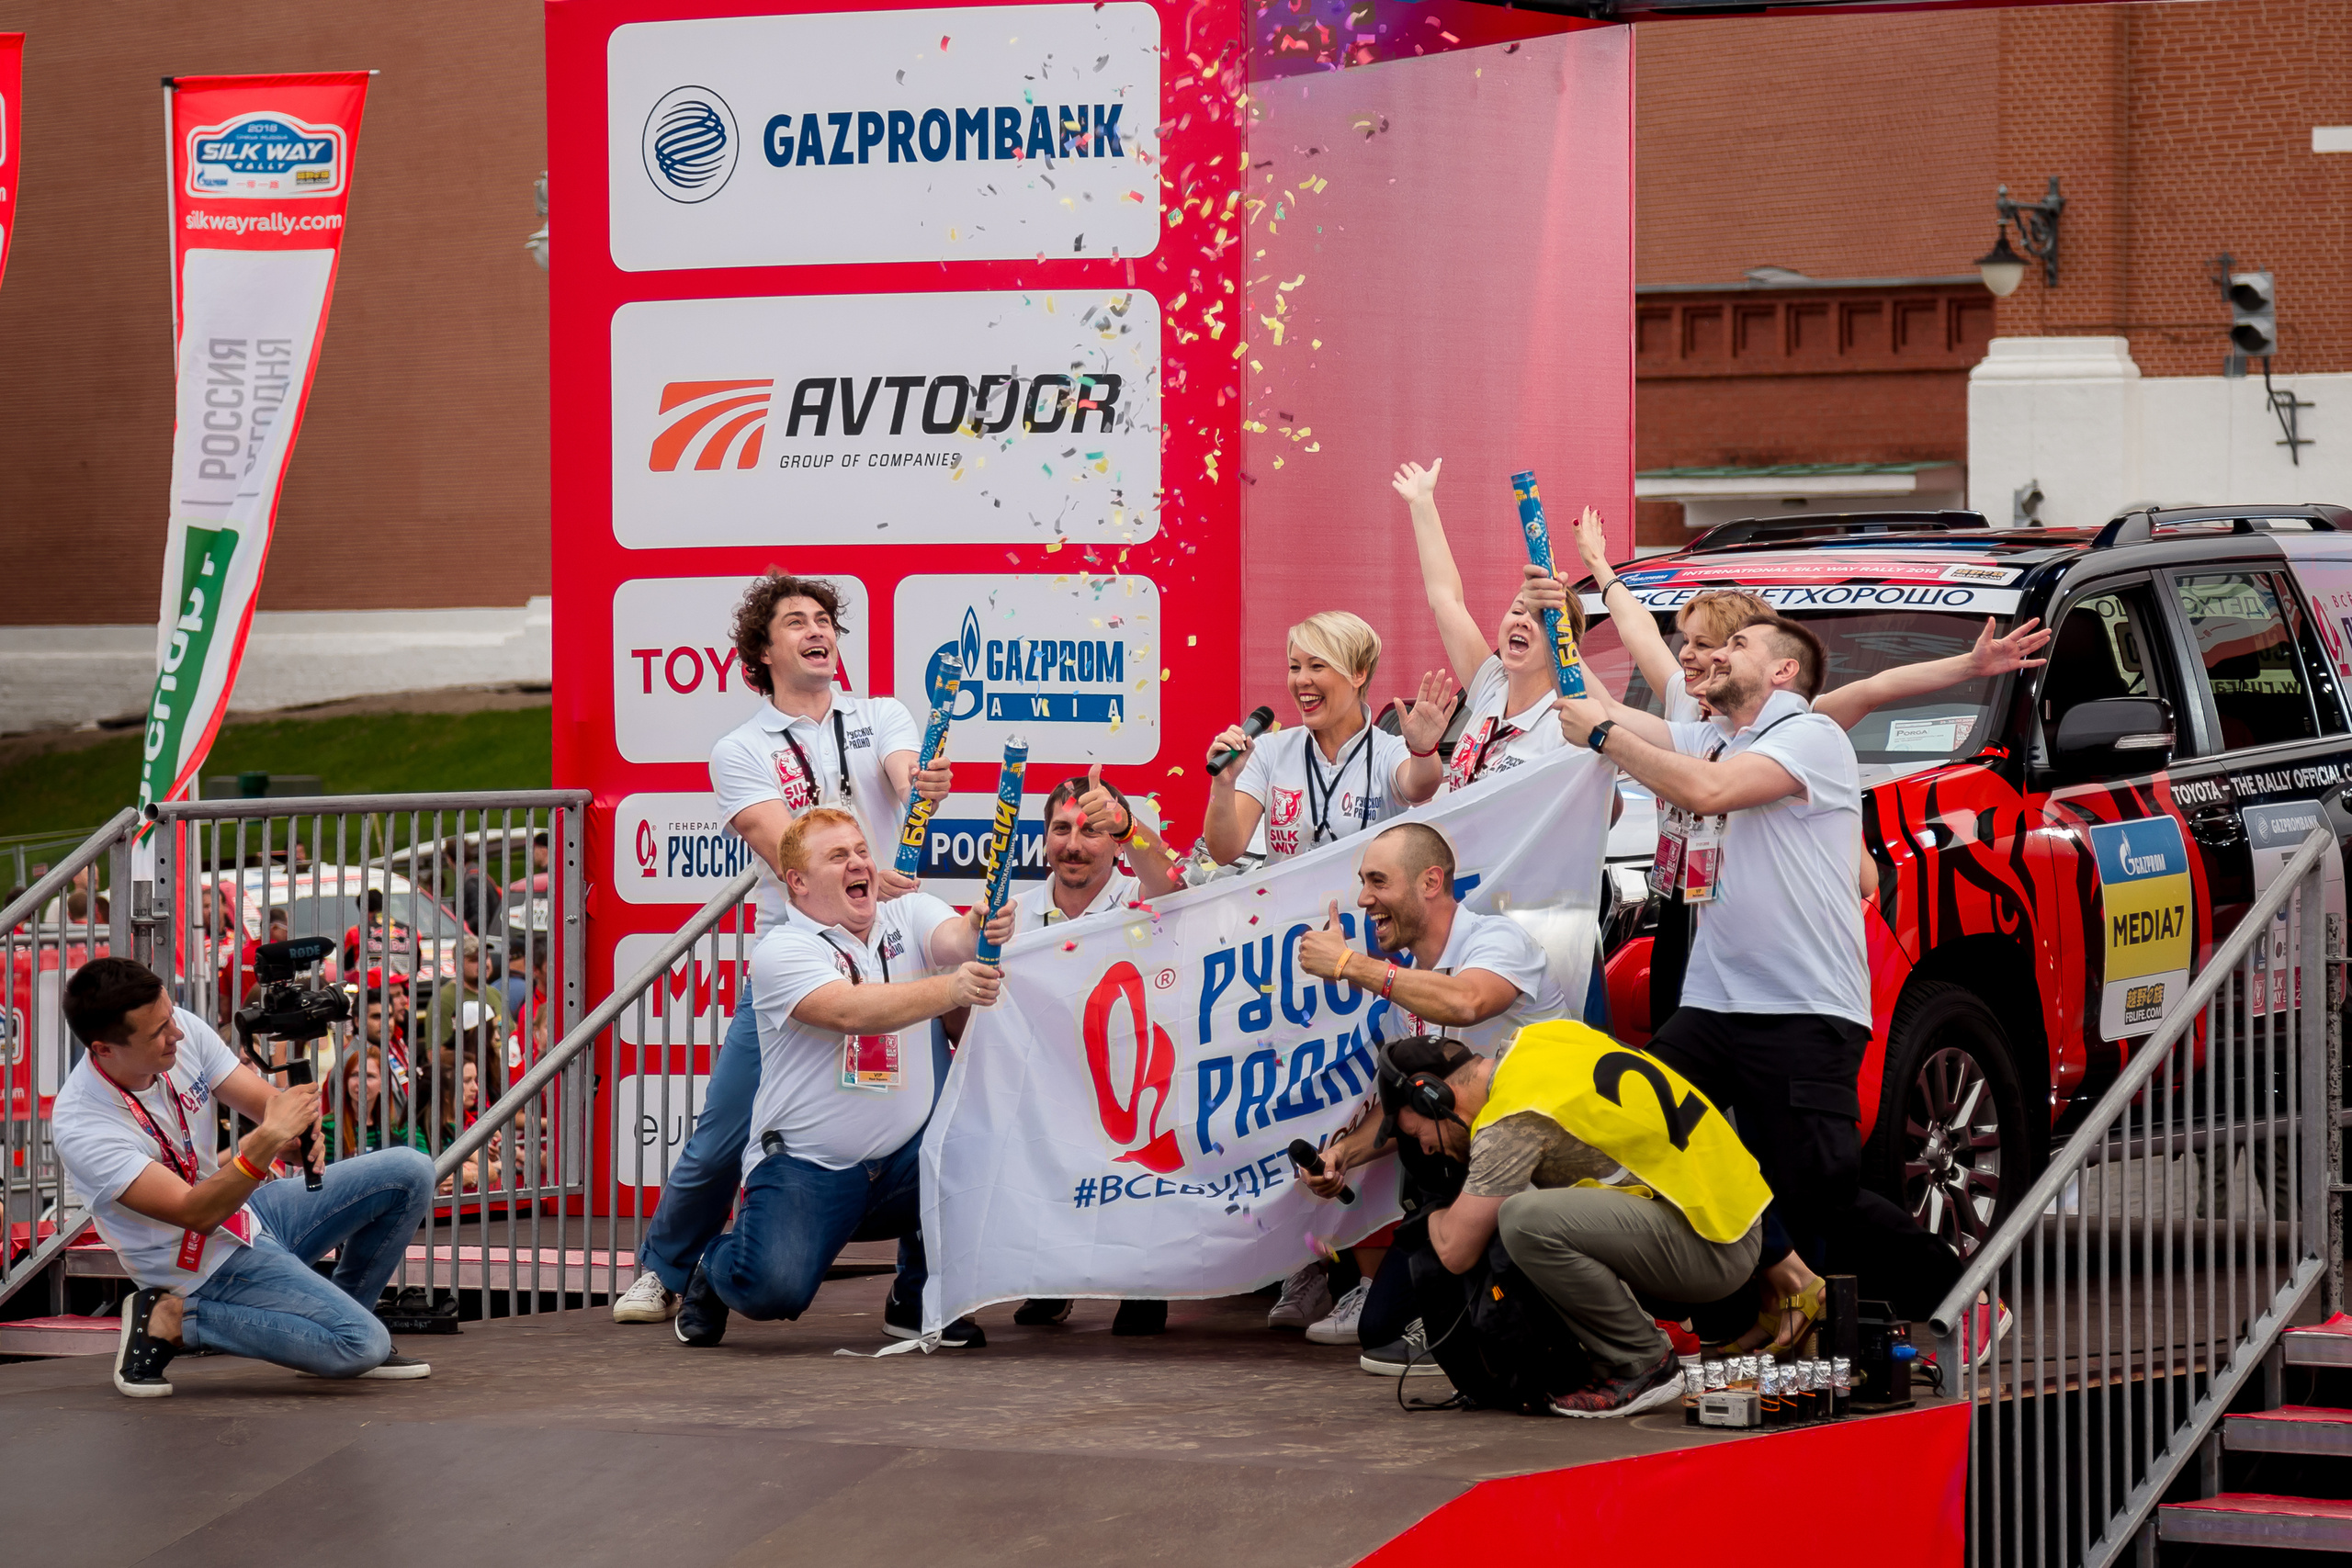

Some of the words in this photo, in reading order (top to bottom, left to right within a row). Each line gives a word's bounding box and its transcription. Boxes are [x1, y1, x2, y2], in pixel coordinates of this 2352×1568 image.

[763, 104, 1125, 168] GAZPROMBANK
[201, 142, 263, 161] SILK
[266, 141, 322, 161] WAY
[234, 162, 285, 170] RALLY
[186, 210, 343, 235] silkwayrally.com
[198, 338, 247, 479] РОССИЯ
[786, 373, 1122, 437] AVTODOR
[779, 454, 834, 469] GROUP
[841, 454, 861, 468] OF
[867, 452, 961, 468] COMPANIES
[1682, 567, 1789, 577] INTERNATIONAL
[631, 646, 854, 695] TOYA
[987, 640, 1124, 682] GAZPROM
[989, 698, 1120, 719] AVIA
[784, 782, 808, 800] SIL
[2171, 781, 2223, 806] TOYOTA
[2230, 774, 2258, 797] THE
[2255, 771, 2292, 794] RALLY
[2292, 764, 2345, 789] OFFICIAL
[1353, 807, 1376, 821] РАИО
[1270, 829, 1299, 842] SILK
[1270, 841, 1298, 855] WAY
[2133, 853, 2166, 874] GAZPROM
[2113, 905, 2185, 948] MEDIA7
[2125, 1007, 2162, 1023] FBLIFE.COM
[1592, 1051, 1709, 1153] 2
